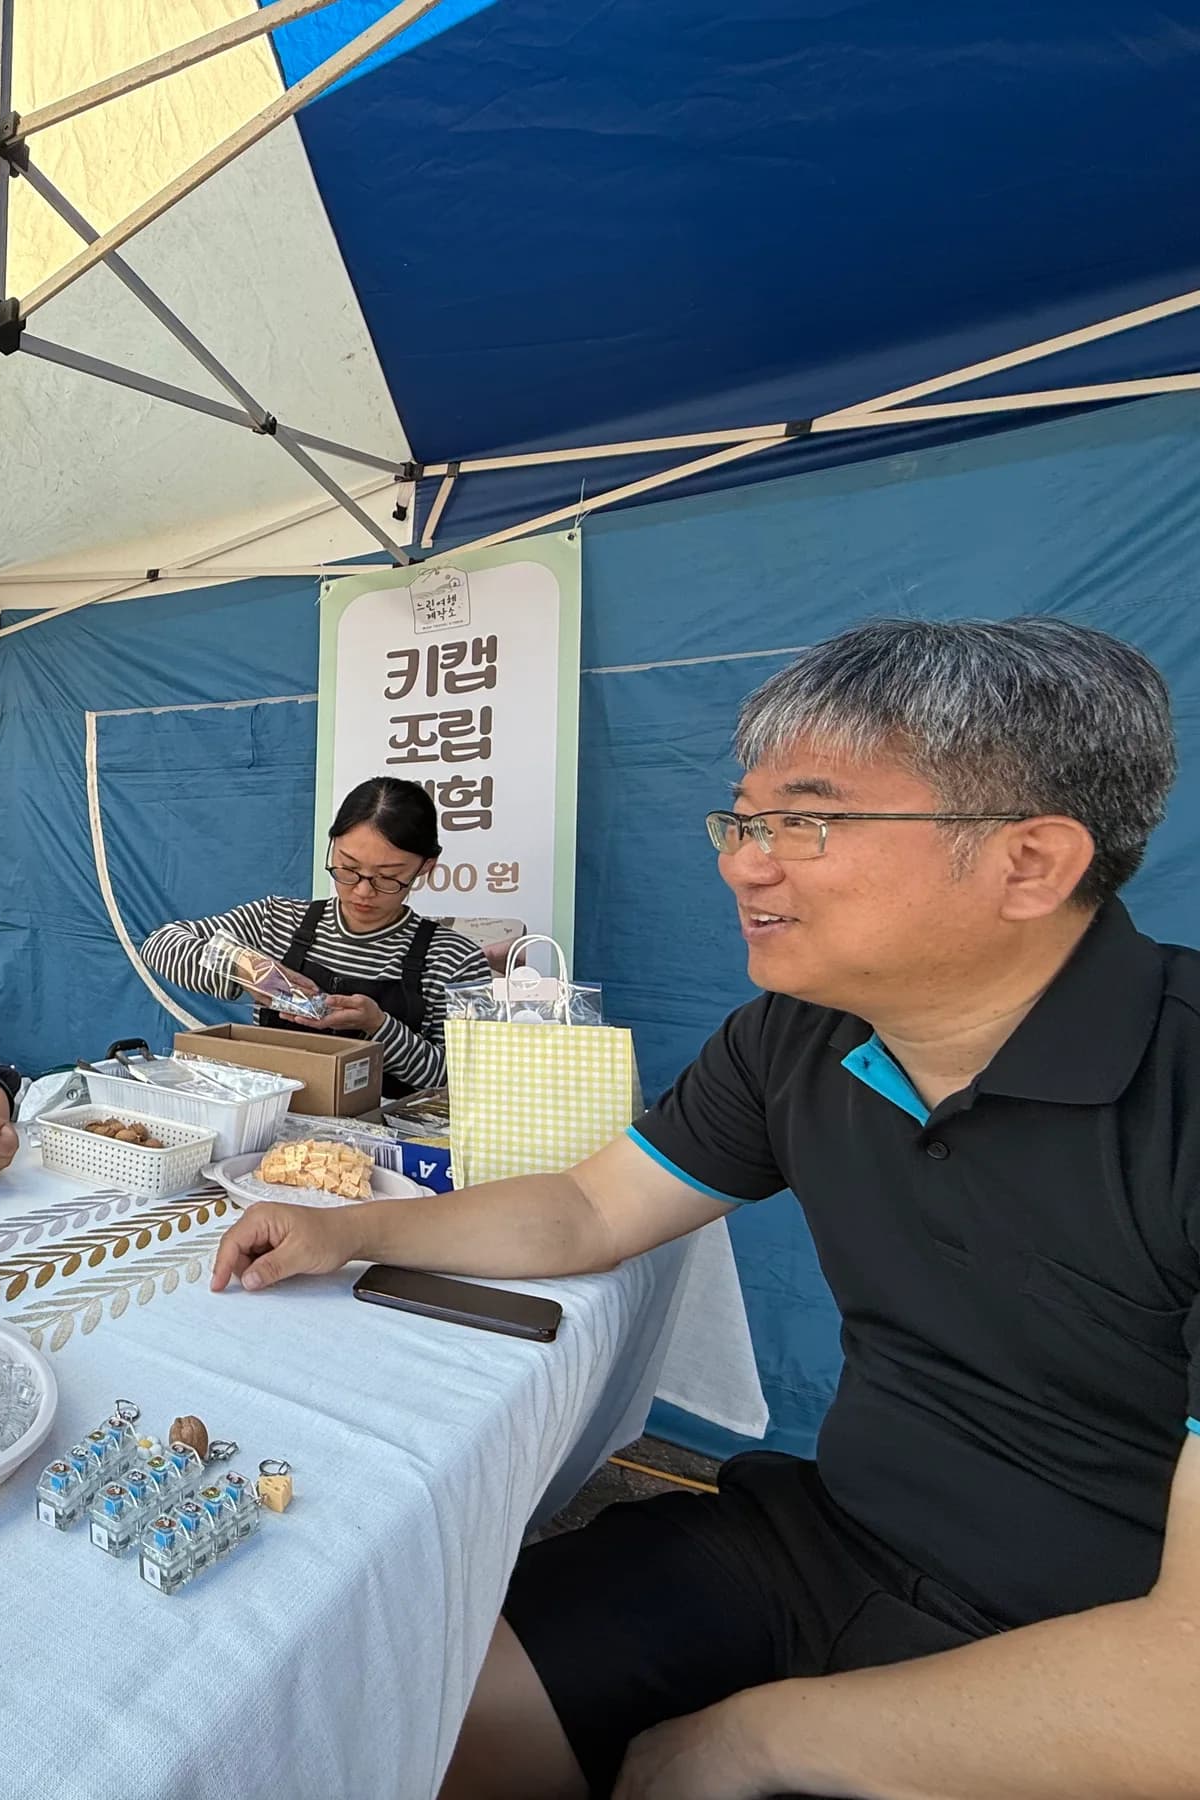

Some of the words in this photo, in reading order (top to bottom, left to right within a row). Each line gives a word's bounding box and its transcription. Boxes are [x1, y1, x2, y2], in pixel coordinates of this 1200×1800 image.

[384, 635, 498, 700] 키캡
[386, 706, 493, 764] 조립
[414, 775, 494, 831] 험
[486, 862, 519, 893] 원
